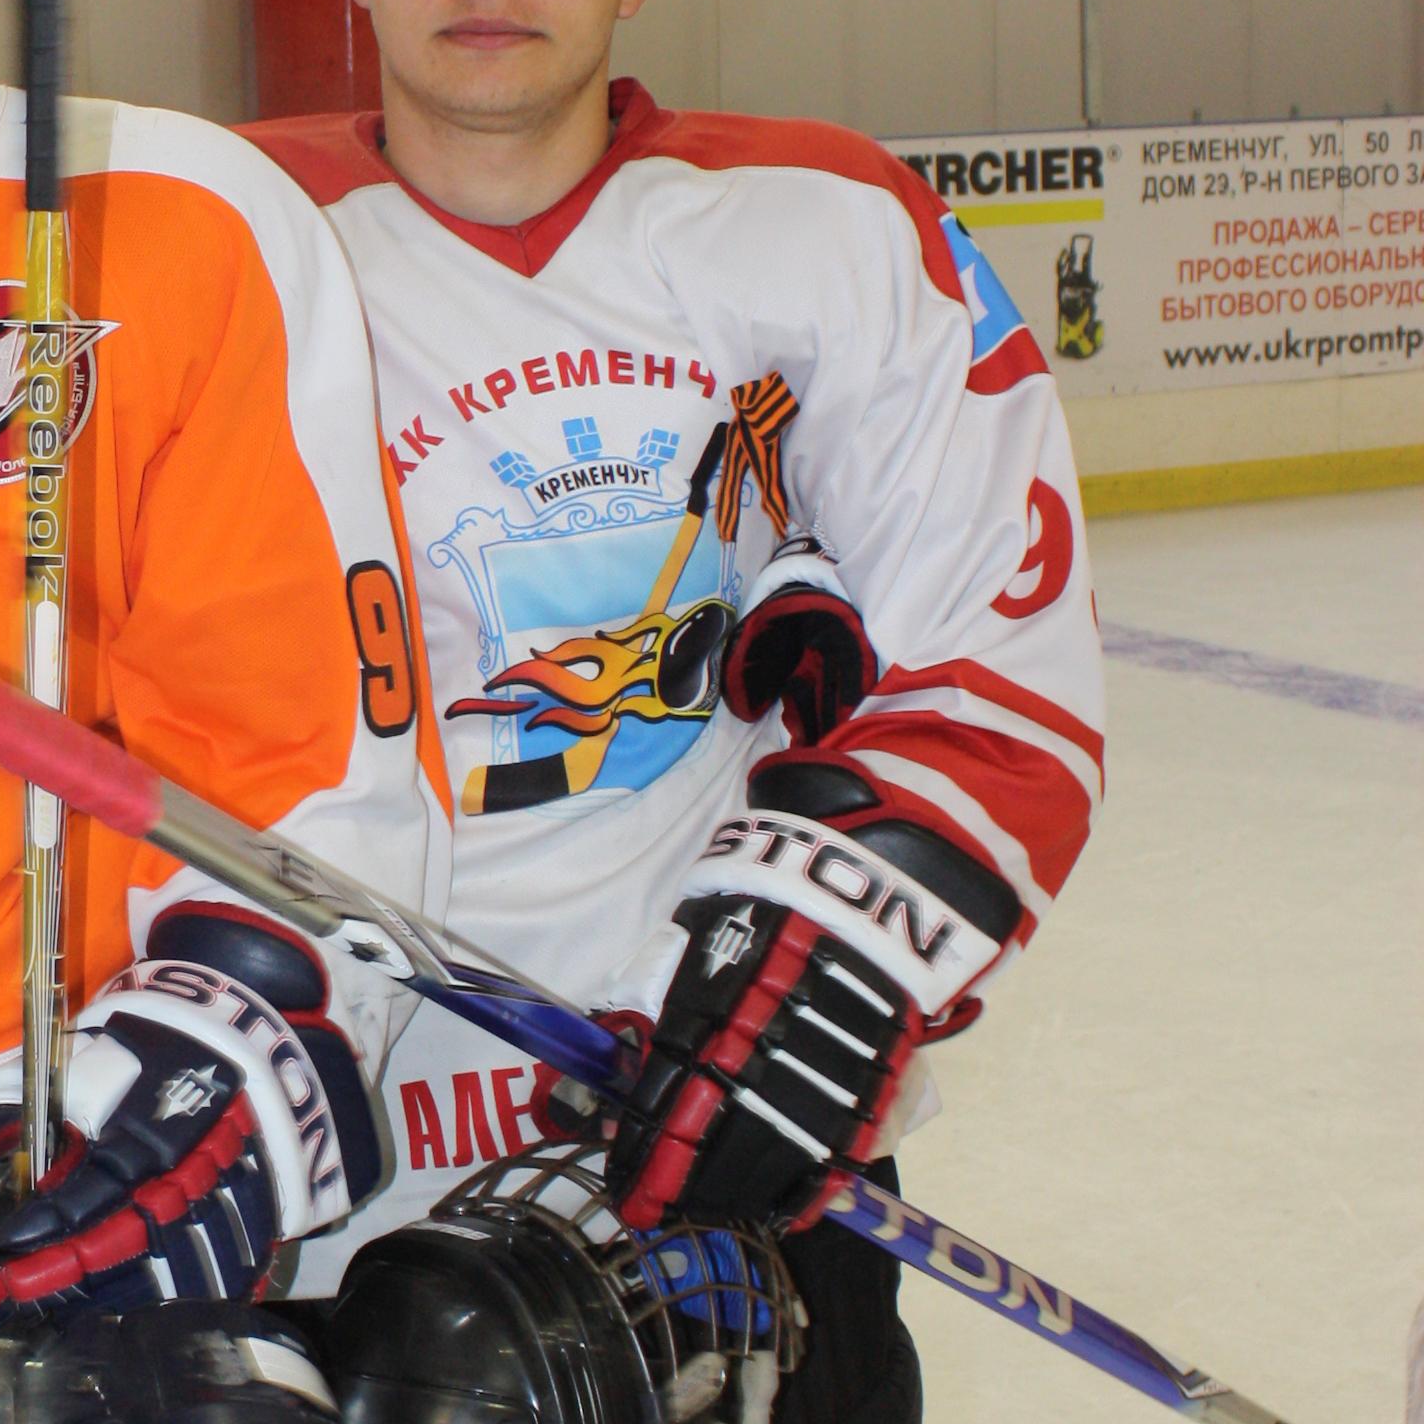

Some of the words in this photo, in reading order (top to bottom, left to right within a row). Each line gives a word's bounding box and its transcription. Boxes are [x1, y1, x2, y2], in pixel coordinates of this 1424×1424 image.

[898, 146, 1104, 196] RCHER
[1366, 131, 1390, 153] 50
[1142, 174, 1196, 204] ДОМ
[1291, 164, 1400, 192] ПЕРВОГО
[1213, 215, 1341, 246] ПРОДАЖА
[1161, 288, 1308, 323] БЫТОВОГО
[448, 348, 717, 423] КРЕМЕНЧ
[28, 321, 67, 597] Reebok
[534, 463, 651, 504] КРЕМЕНЧУГ
[345, 559, 418, 739] 9
[698, 815, 959, 973] STON
[103, 962, 344, 1208] ASTON
[400, 1061, 551, 1170] АЛЕ
